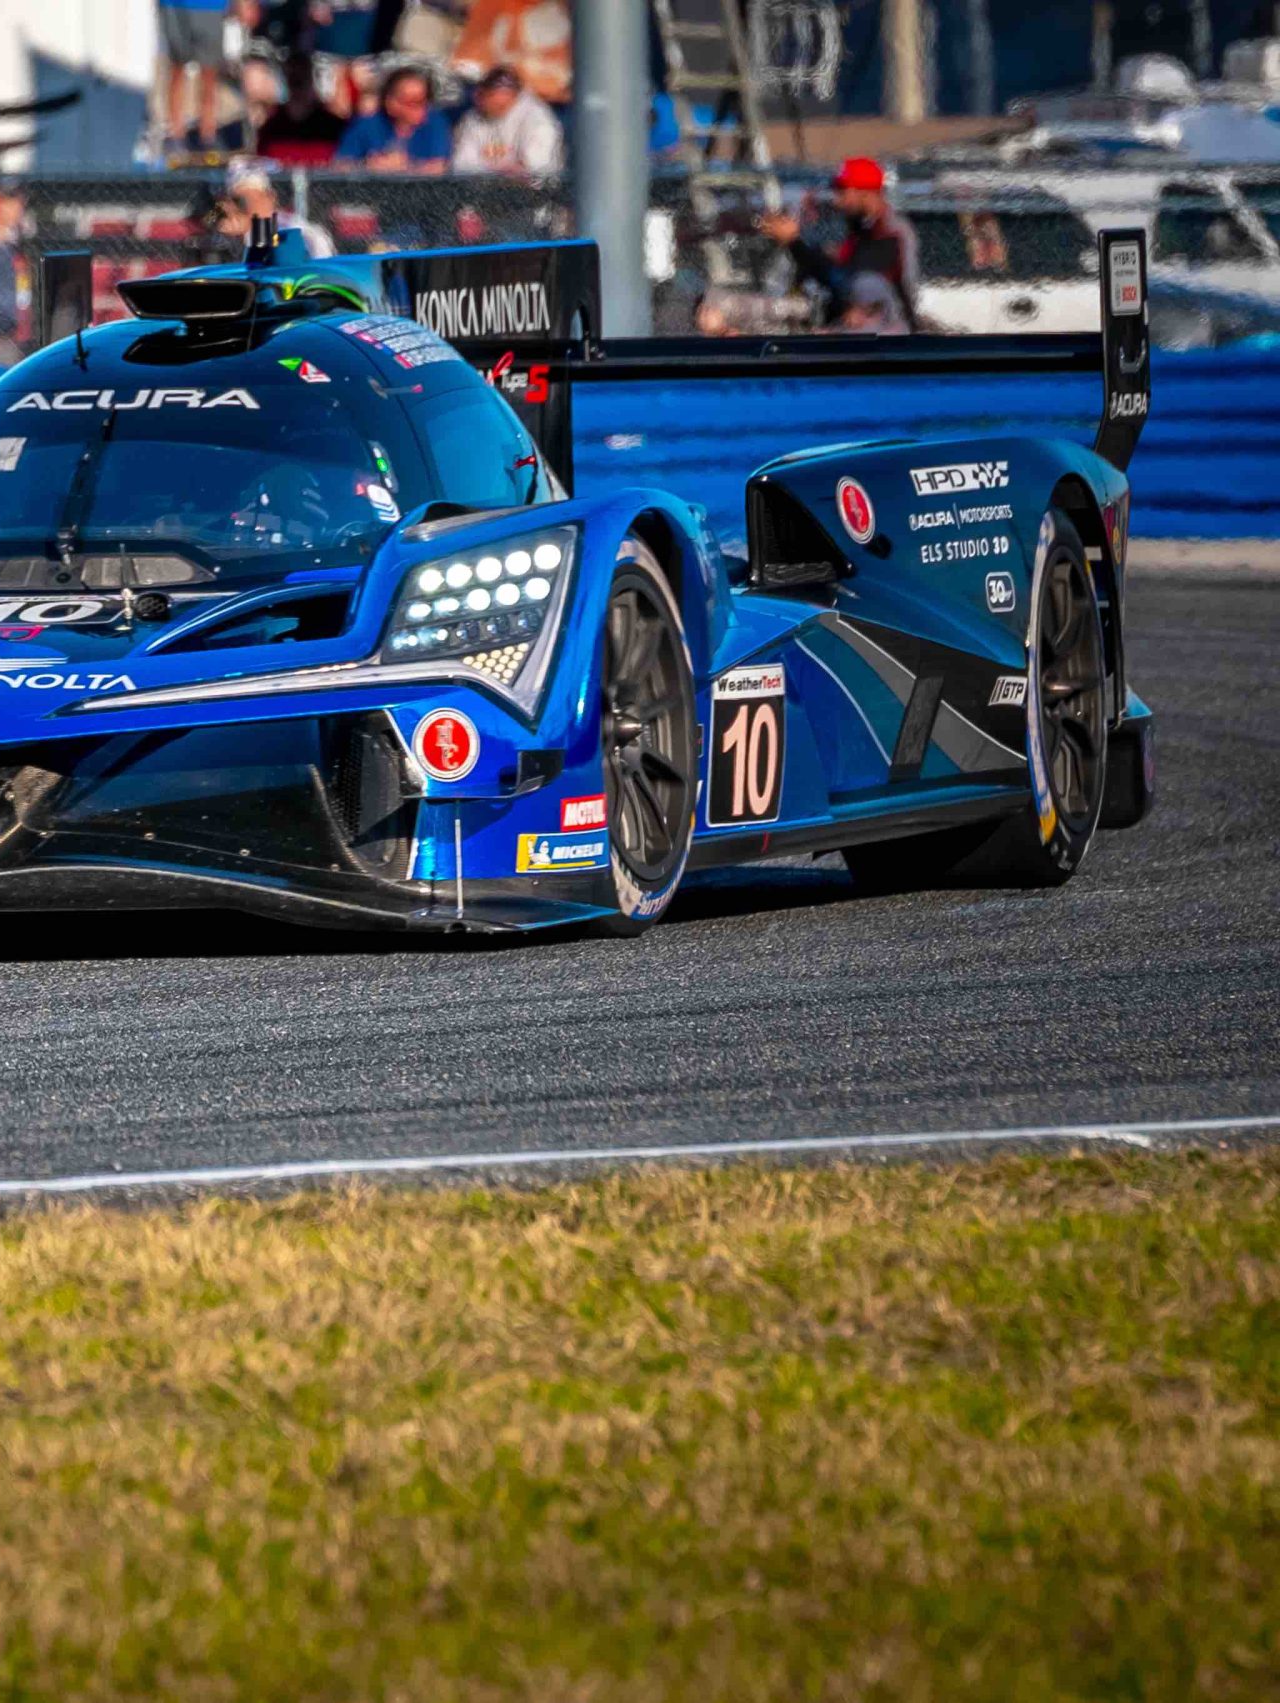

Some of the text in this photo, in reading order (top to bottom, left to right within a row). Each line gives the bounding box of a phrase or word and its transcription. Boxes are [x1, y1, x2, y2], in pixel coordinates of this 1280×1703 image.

[416, 282, 550, 337] KONICA MINOLTA
[501, 368, 527, 392] Type
[6, 388, 261, 413] ACURA
[1118, 391, 1147, 417] ACURA
[914, 469, 966, 492] HPD
[918, 504, 1013, 529] ACURA MOTORSPORTS
[921, 535, 1010, 563] ELS STUDIO 3D
[717, 675, 782, 693] WeatherTech
[1001, 681, 1024, 700] GTP
[722, 703, 778, 817] 10
[563, 799, 606, 827] MOTUL
[551, 842, 605, 860] MICHELIN
